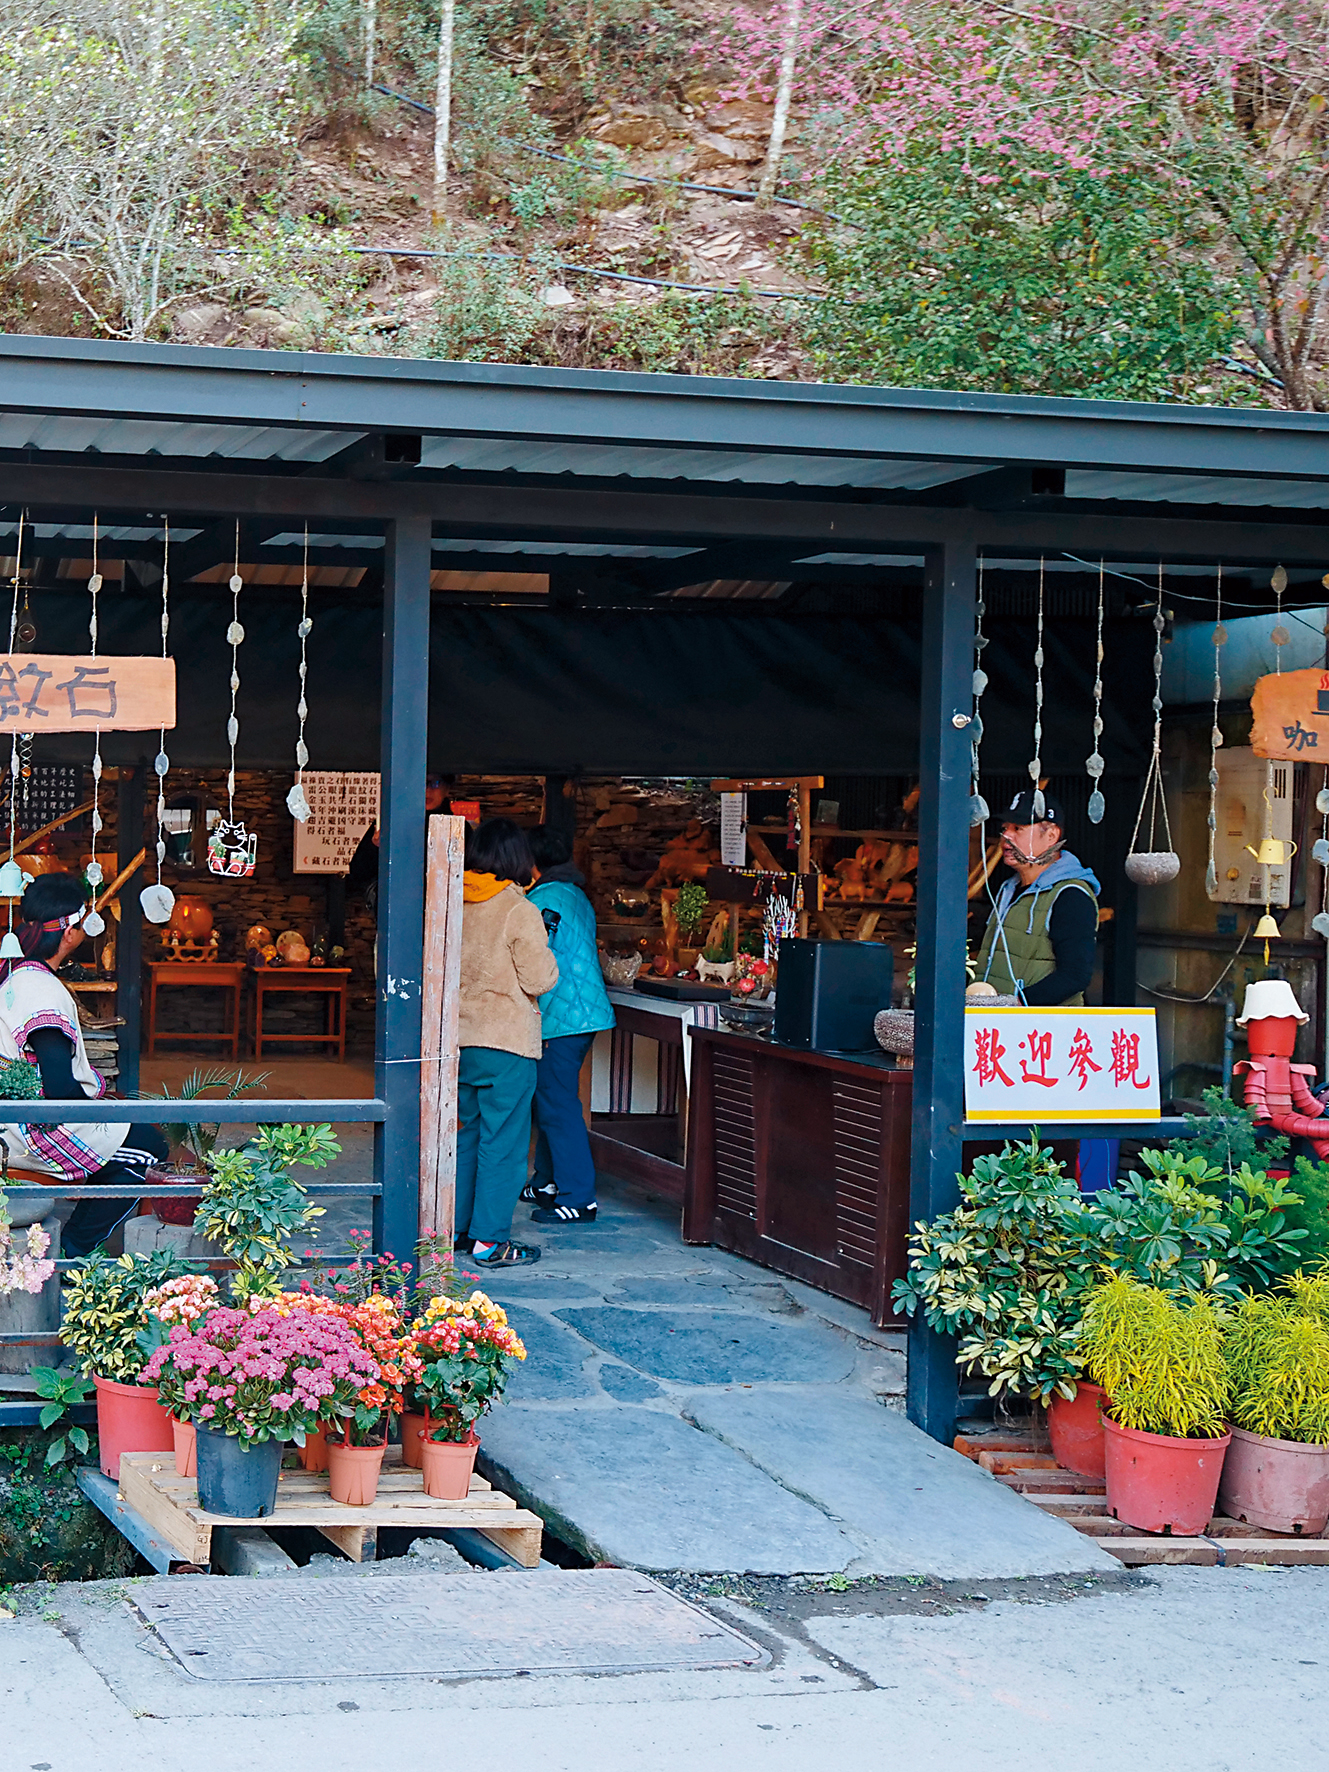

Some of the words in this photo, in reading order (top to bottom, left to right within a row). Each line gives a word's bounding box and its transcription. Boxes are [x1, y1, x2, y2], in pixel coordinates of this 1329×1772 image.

[1282, 720, 1318, 751] 咖
[1048, 809, 1055, 819] 3
[307, 826, 346, 835] 得石者福
[972, 1028, 1151, 1091] 歡迎參觀
